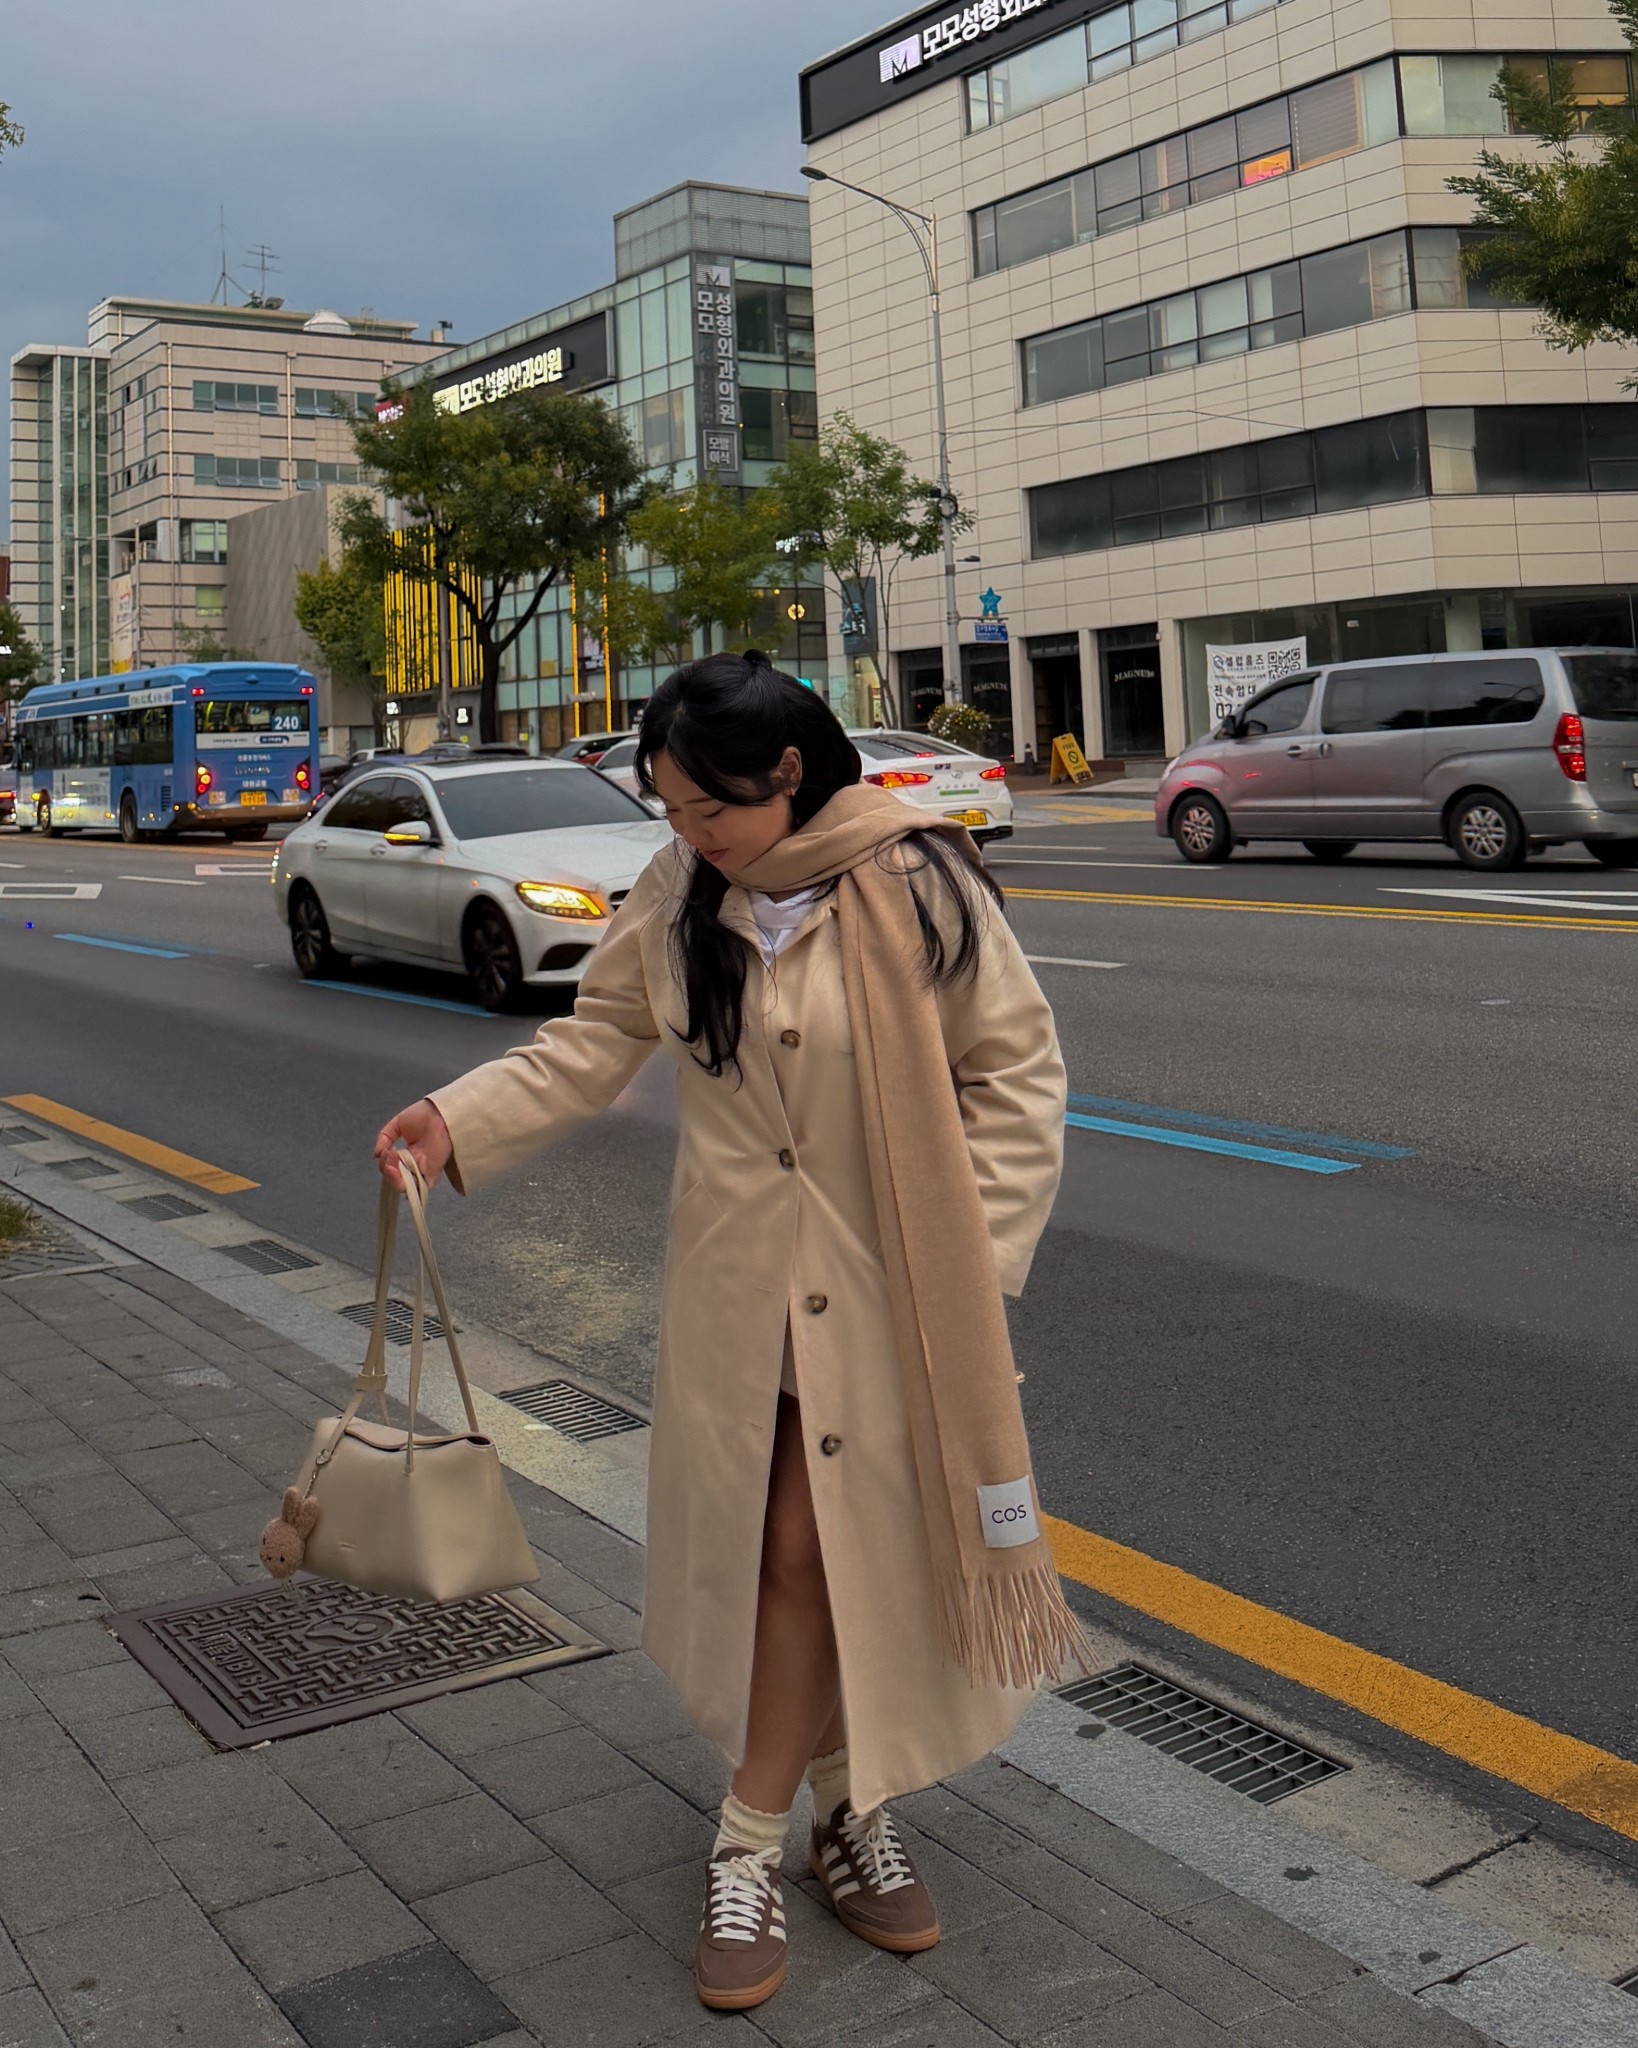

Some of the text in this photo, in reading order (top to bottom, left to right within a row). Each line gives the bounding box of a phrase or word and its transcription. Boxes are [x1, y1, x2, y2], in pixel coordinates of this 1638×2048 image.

[697, 290, 714, 334] 모모
[715, 292, 736, 425] 성형외과의원
[1113, 669, 1155, 682] MAGNUM
[274, 715, 300, 731] 240
[991, 1504, 1027, 1524] COS
